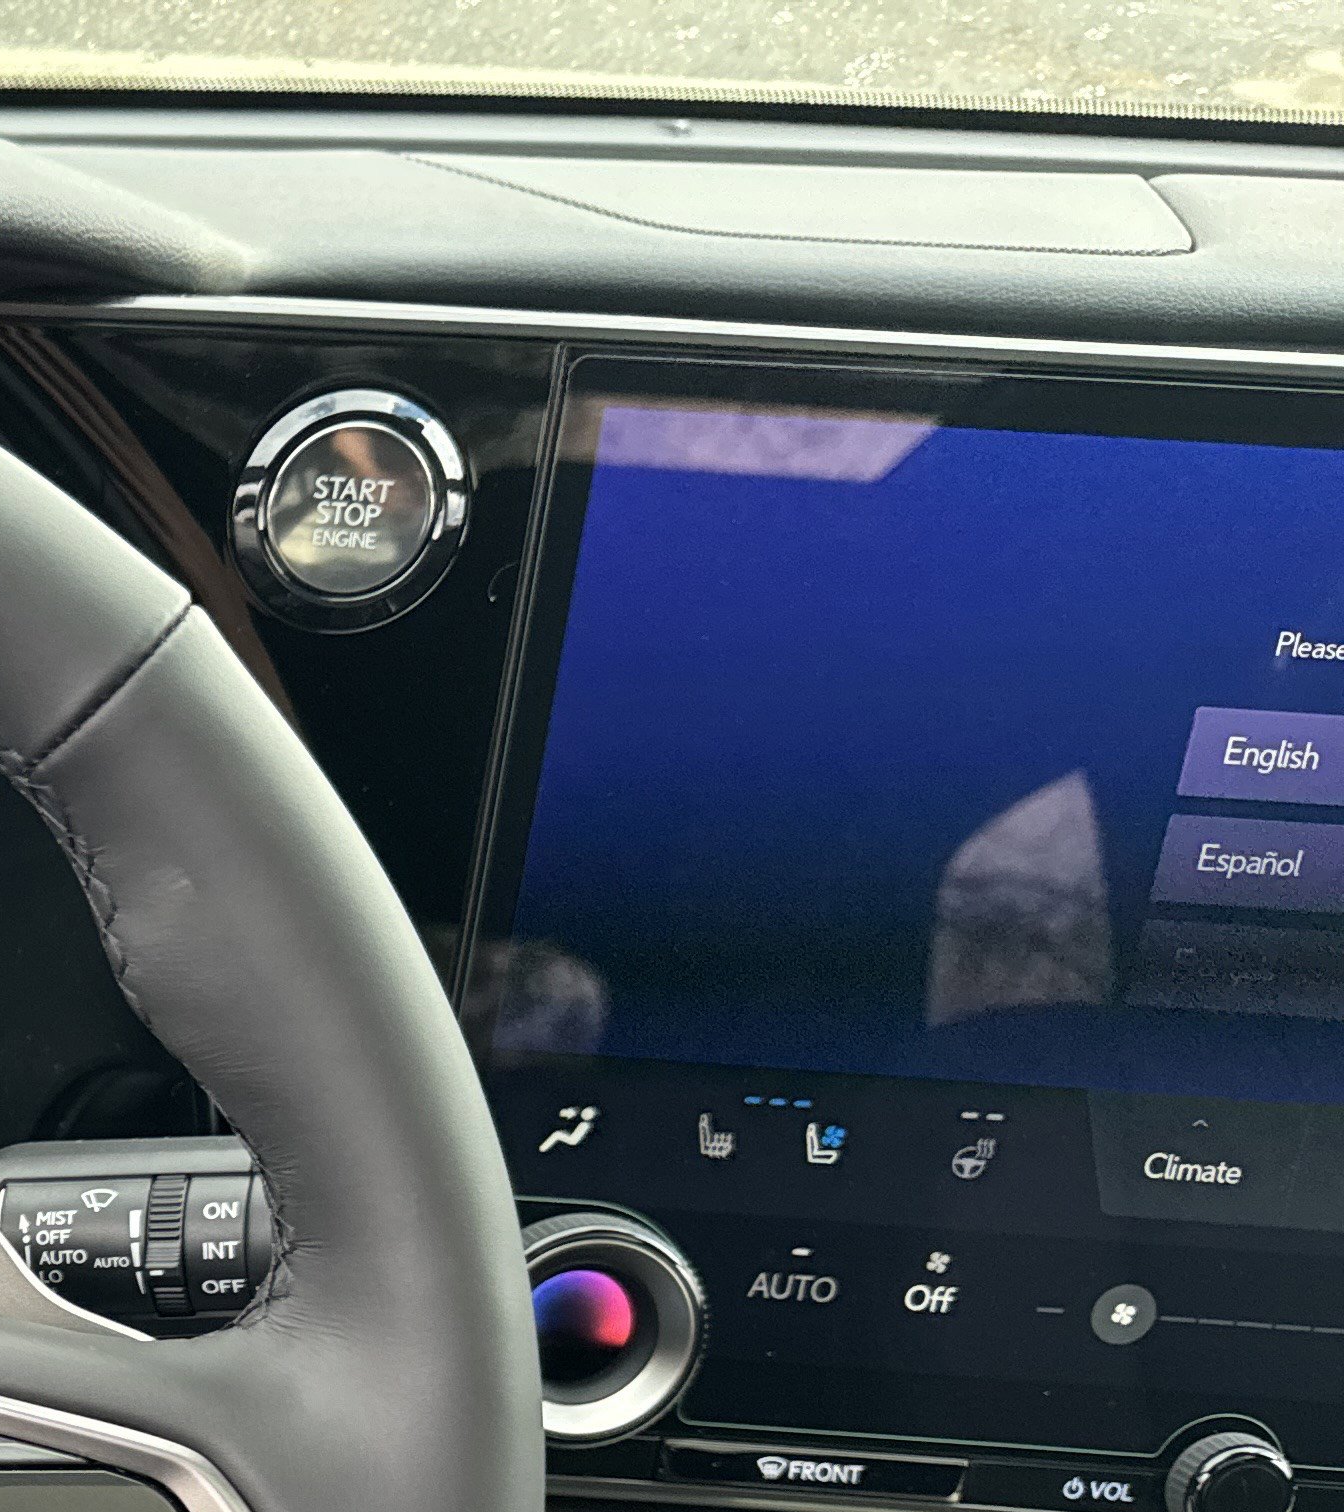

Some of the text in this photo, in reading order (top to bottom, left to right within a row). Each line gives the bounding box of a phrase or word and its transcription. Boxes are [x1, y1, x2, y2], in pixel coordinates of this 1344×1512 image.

[313, 475, 394, 503] START
[315, 502, 383, 527] STOP
[312, 529, 377, 549] ENGINE
[1223, 736, 1320, 774] English
[1197, 843, 1303, 879] Español
[1143, 1153, 1242, 1187] Climate
[35, 1209, 77, 1226] MIST
[203, 1202, 238, 1219] ON
[35, 1229, 72, 1246] OFF
[39, 1249, 89, 1266] AUTO
[93, 1255, 130, 1269] AUTO
[202, 1241, 239, 1261] INT
[202, 1278, 247, 1295] OFF
[747, 1271, 838, 1305] AUTO
[904, 1284, 958, 1314] Off
[786, 1459, 865, 1485] FRONT
[1089, 1480, 1135, 1503] VOL
